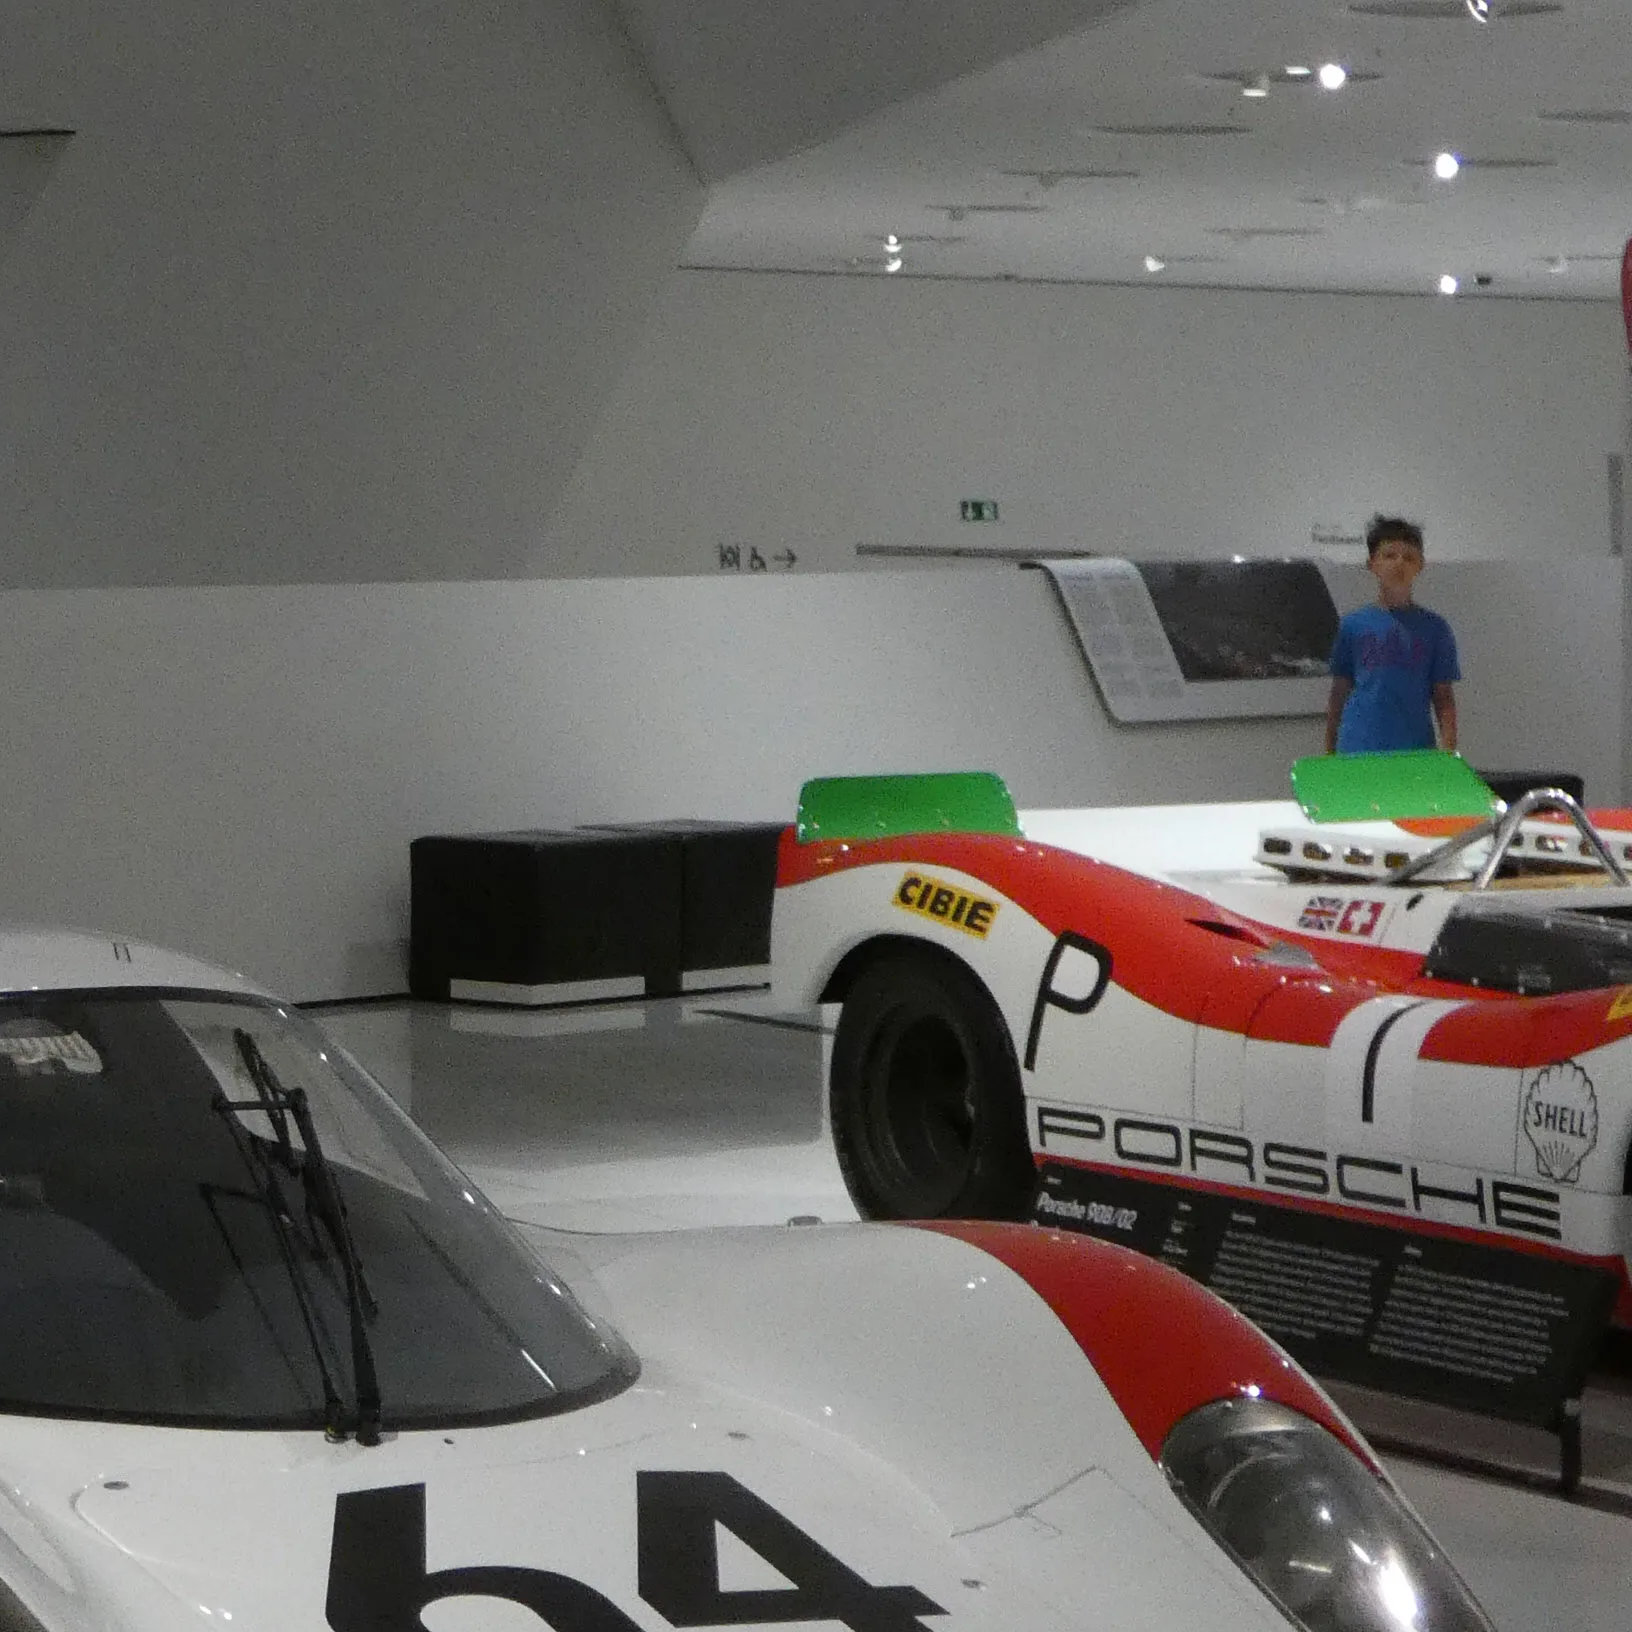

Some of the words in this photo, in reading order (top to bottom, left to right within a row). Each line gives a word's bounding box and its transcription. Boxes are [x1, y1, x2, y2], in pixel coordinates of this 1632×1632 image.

[899, 876, 994, 934] CIBIE
[1023, 929, 1114, 1072] P
[1533, 1100, 1587, 1138] SHELL
[1037, 1106, 1563, 1241] PORSCHE
[1037, 1191, 1086, 1219] Porsche
